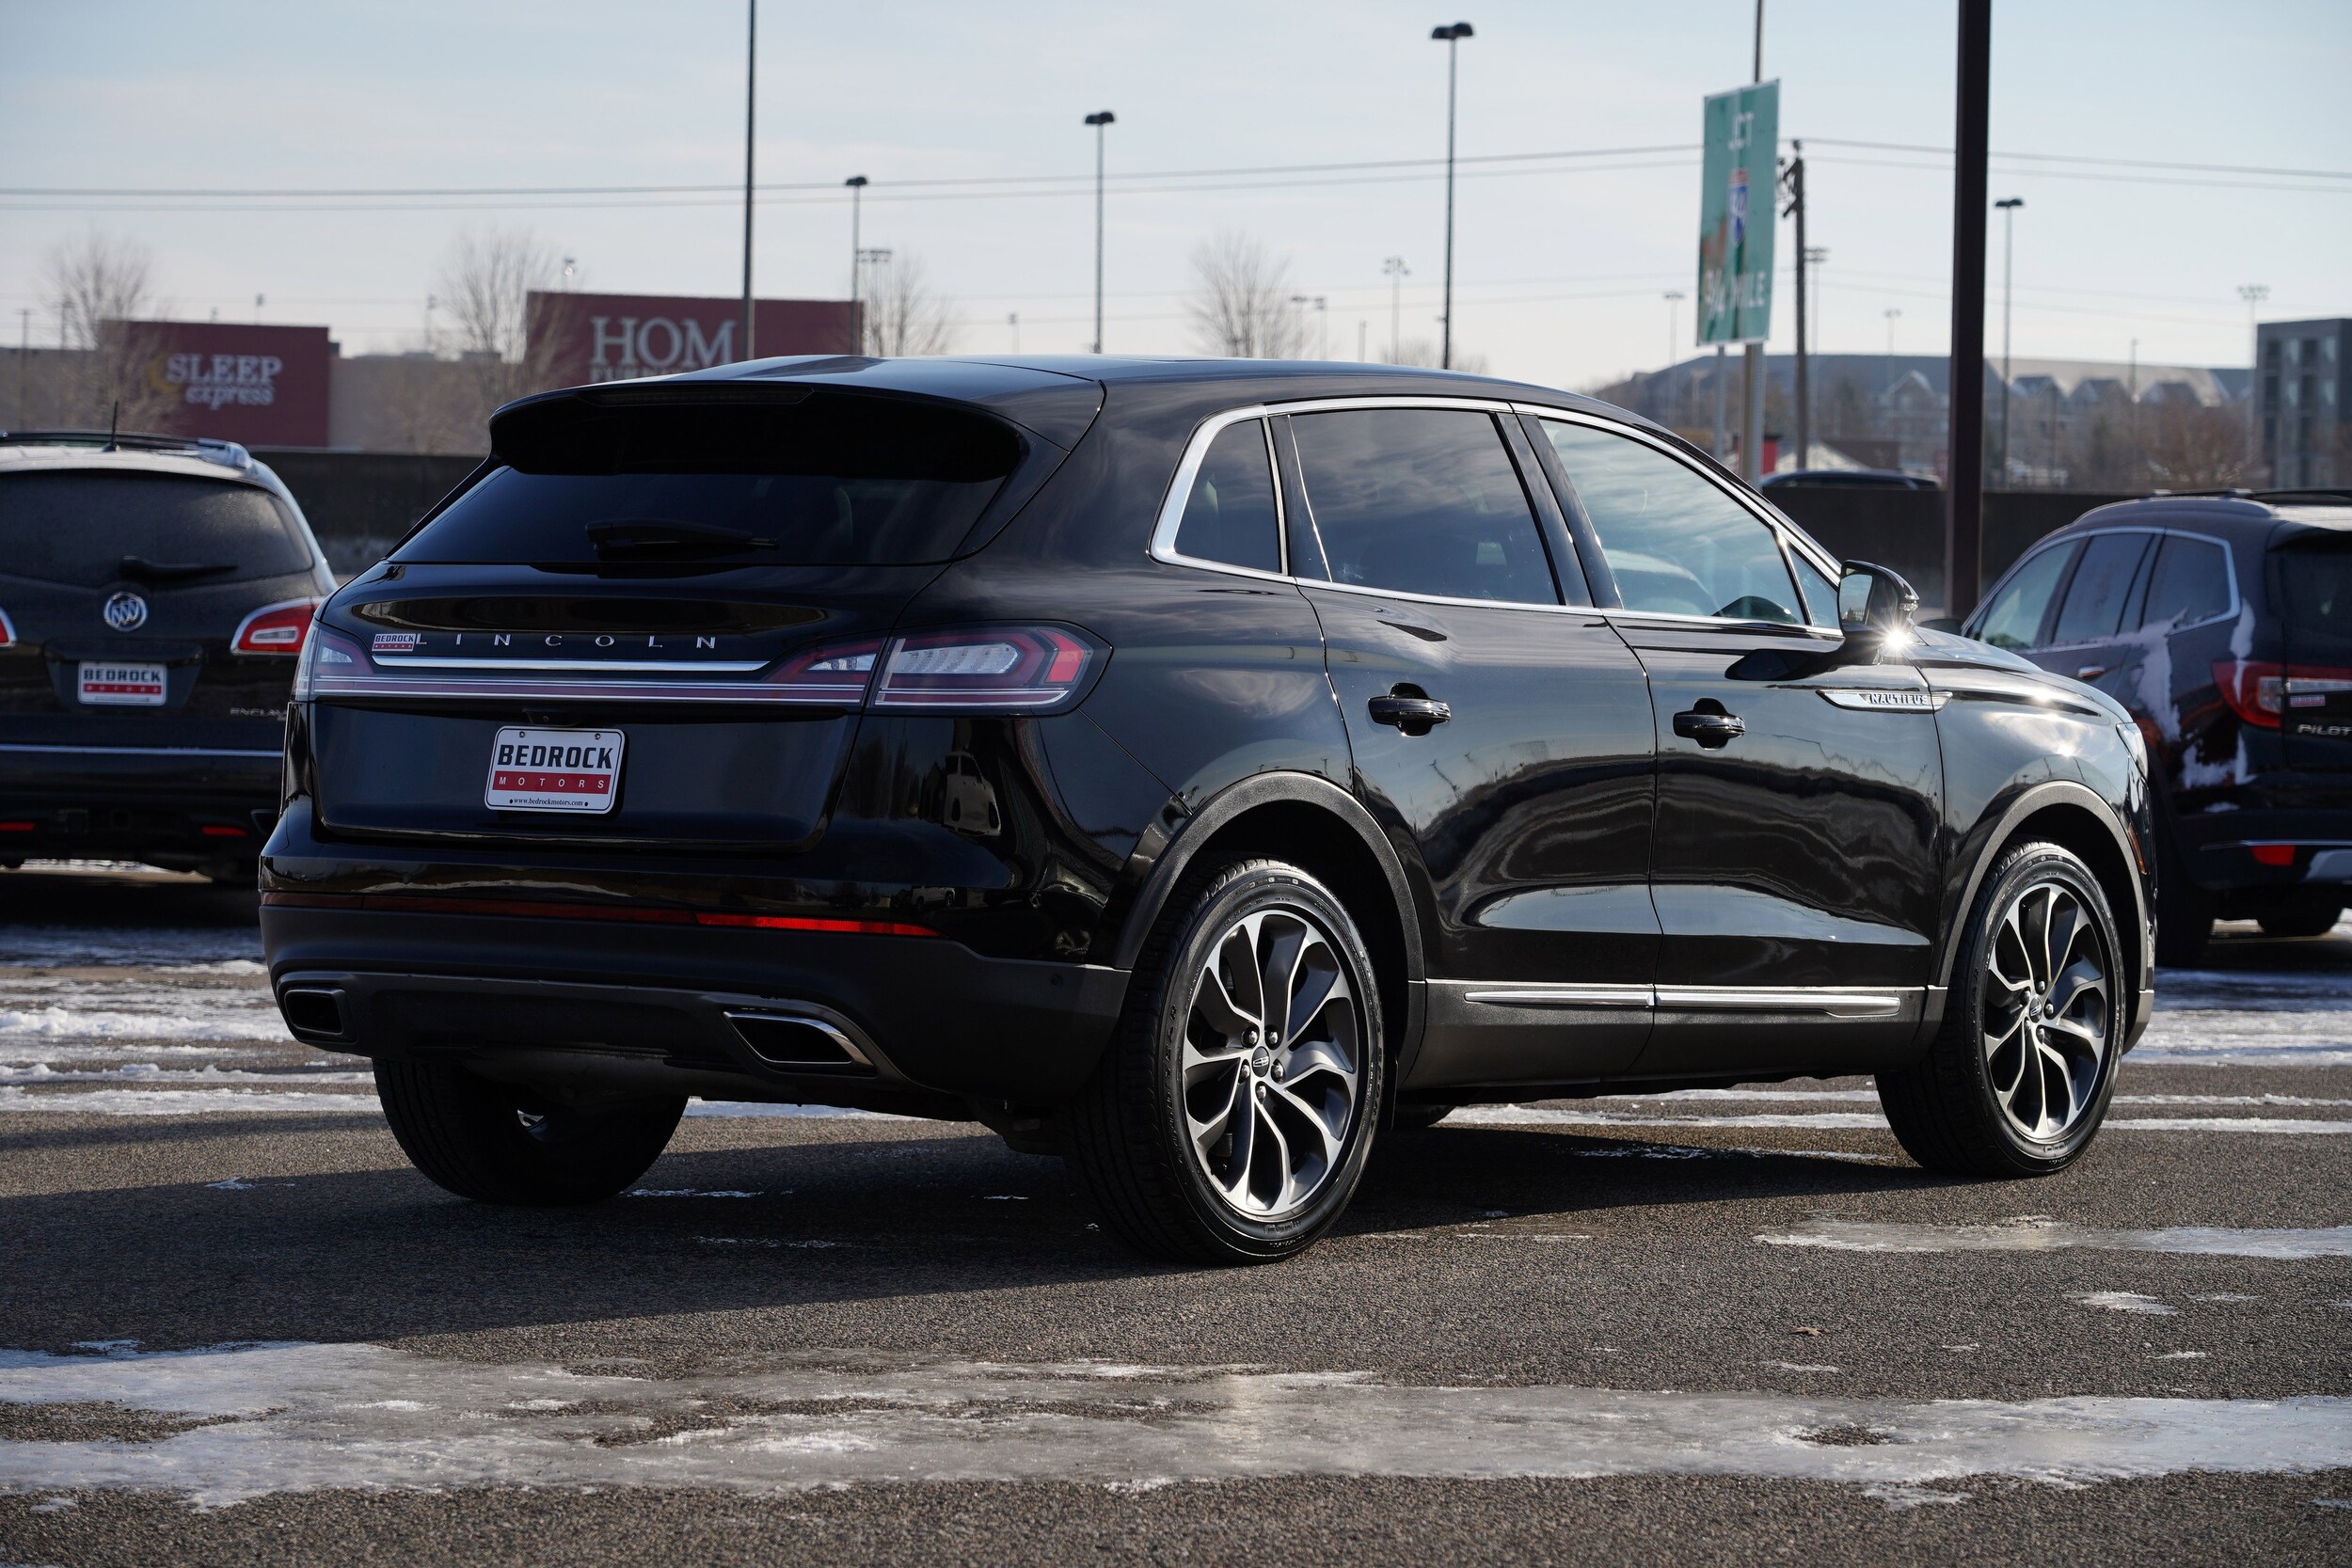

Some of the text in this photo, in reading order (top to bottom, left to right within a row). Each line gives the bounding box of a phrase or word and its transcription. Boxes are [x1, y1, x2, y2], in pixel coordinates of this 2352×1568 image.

[589, 315, 738, 370] HOM
[167, 353, 282, 384] SLEEP
[185, 385, 274, 410] express
[374, 634, 414, 642] BEDROCK
[416, 633, 716, 649] LINCOLN
[84, 669, 160, 683] BEDROCK
[2297, 723, 2352, 736] PILOT
[498, 744, 613, 769] BEDROCK
[499, 776, 604, 788] MOTORS
[514, 798, 583, 806] www.bedrockmotors.com
